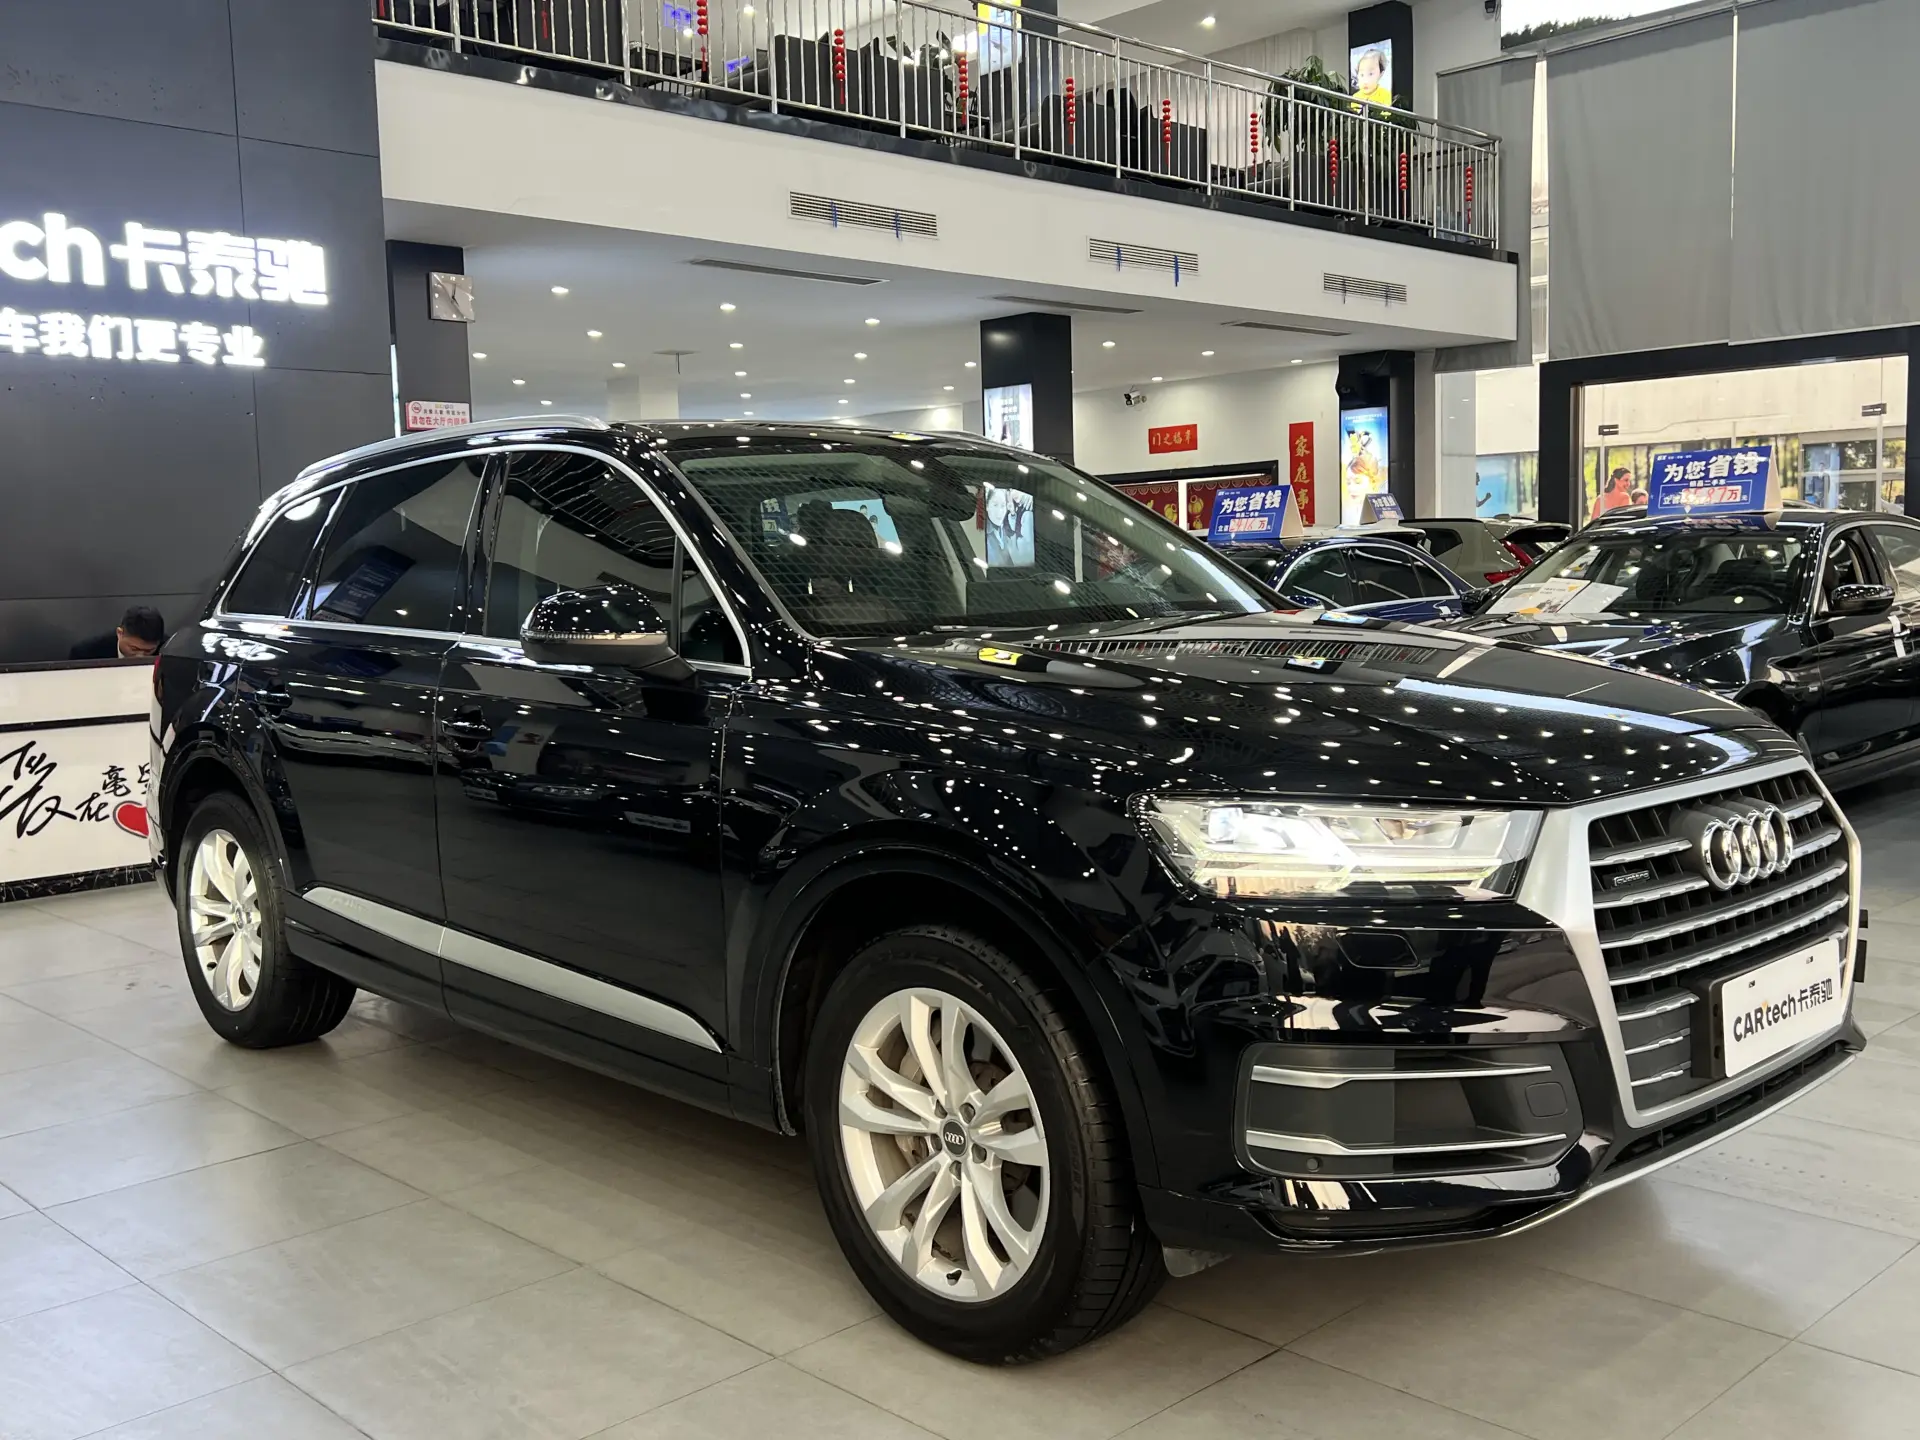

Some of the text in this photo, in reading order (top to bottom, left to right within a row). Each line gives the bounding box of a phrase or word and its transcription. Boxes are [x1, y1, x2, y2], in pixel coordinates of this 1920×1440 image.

[1662, 451, 1760, 484] 为您省钱
[1219, 489, 1282, 515] 为您省钱
